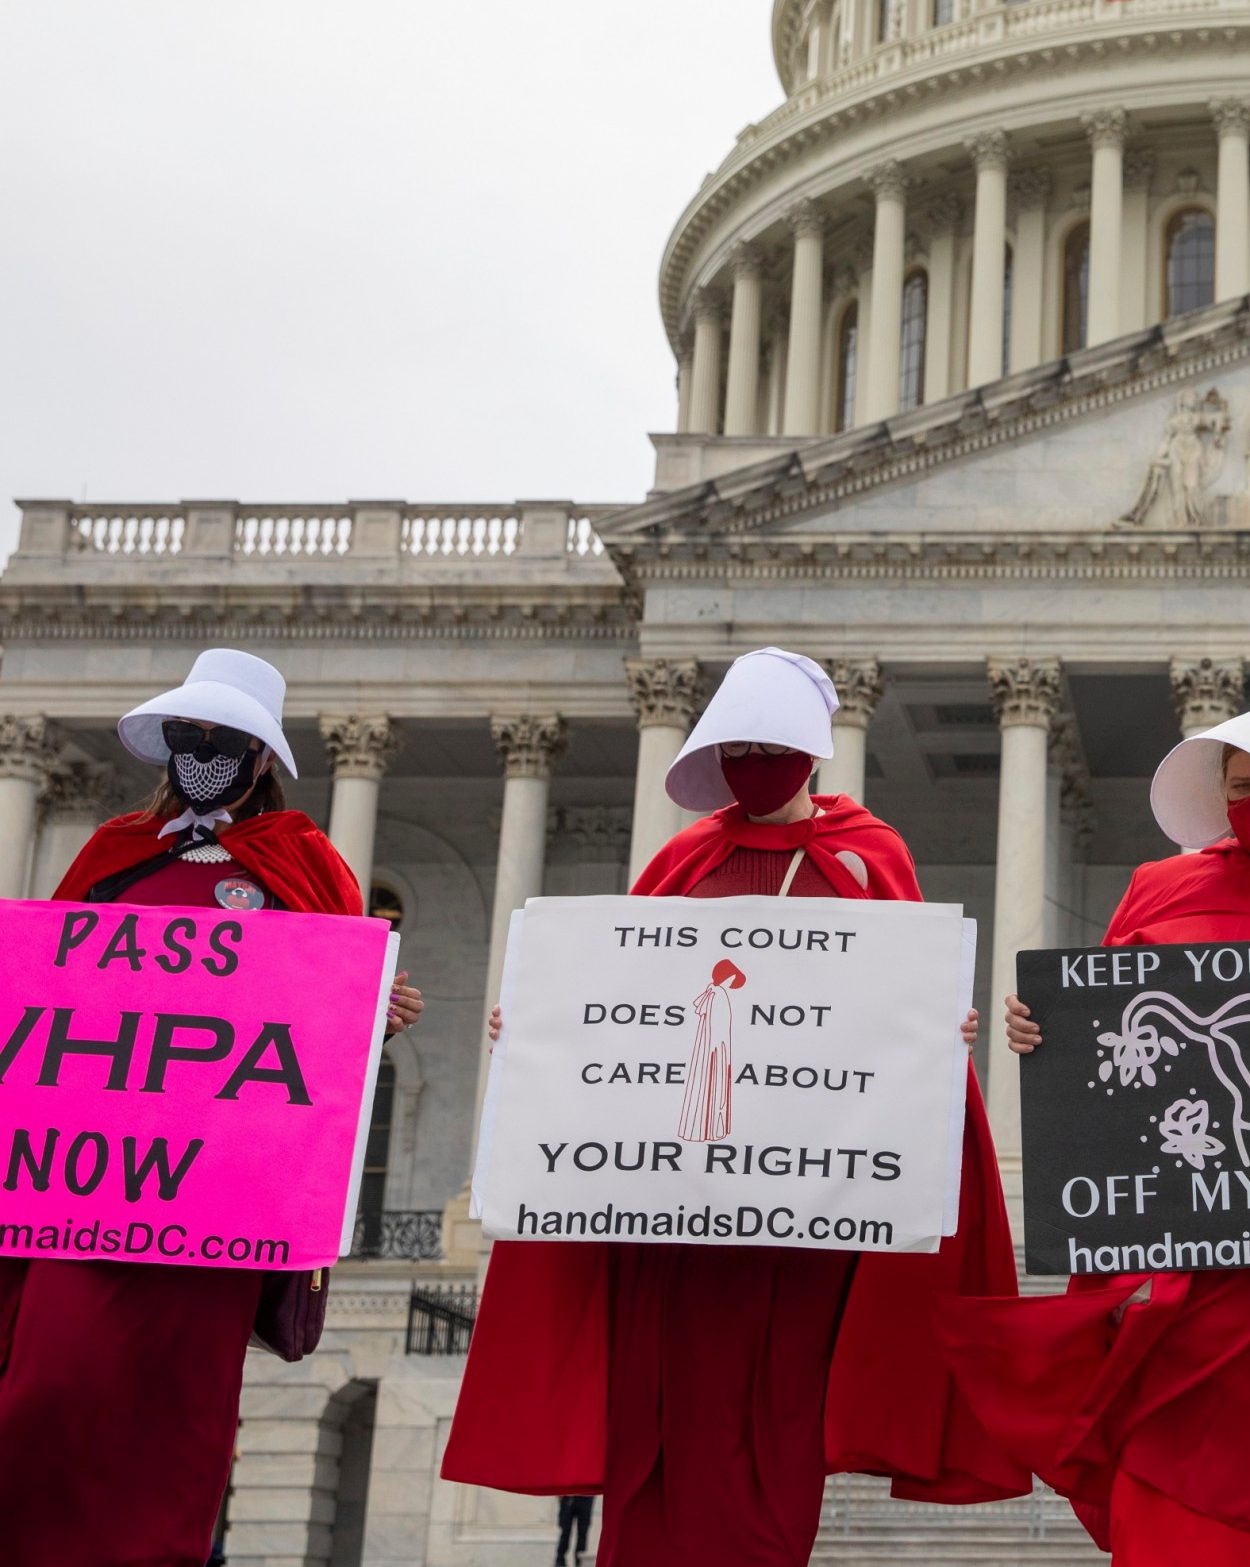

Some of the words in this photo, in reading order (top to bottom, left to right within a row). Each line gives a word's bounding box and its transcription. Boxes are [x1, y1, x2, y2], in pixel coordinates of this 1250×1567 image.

[54, 910, 243, 977] PASS
[614, 926, 698, 948] THIS
[720, 927, 857, 953] COURT
[1061, 951, 1161, 988] KEEP
[583, 1003, 686, 1027] DOES
[750, 1004, 832, 1028] NOT
[581, 1062, 686, 1085] CARE
[735, 1063, 875, 1093] ABOUT
[2, 1127, 205, 1203] NOW
[538, 1141, 683, 1172] YOUR
[705, 1143, 902, 1181] RIGHTS
[1061, 1174, 1158, 1218] OFF
[0, 1218, 290, 1264] maidsDC.com
[516, 1203, 893, 1246] handmaidsDC.com
